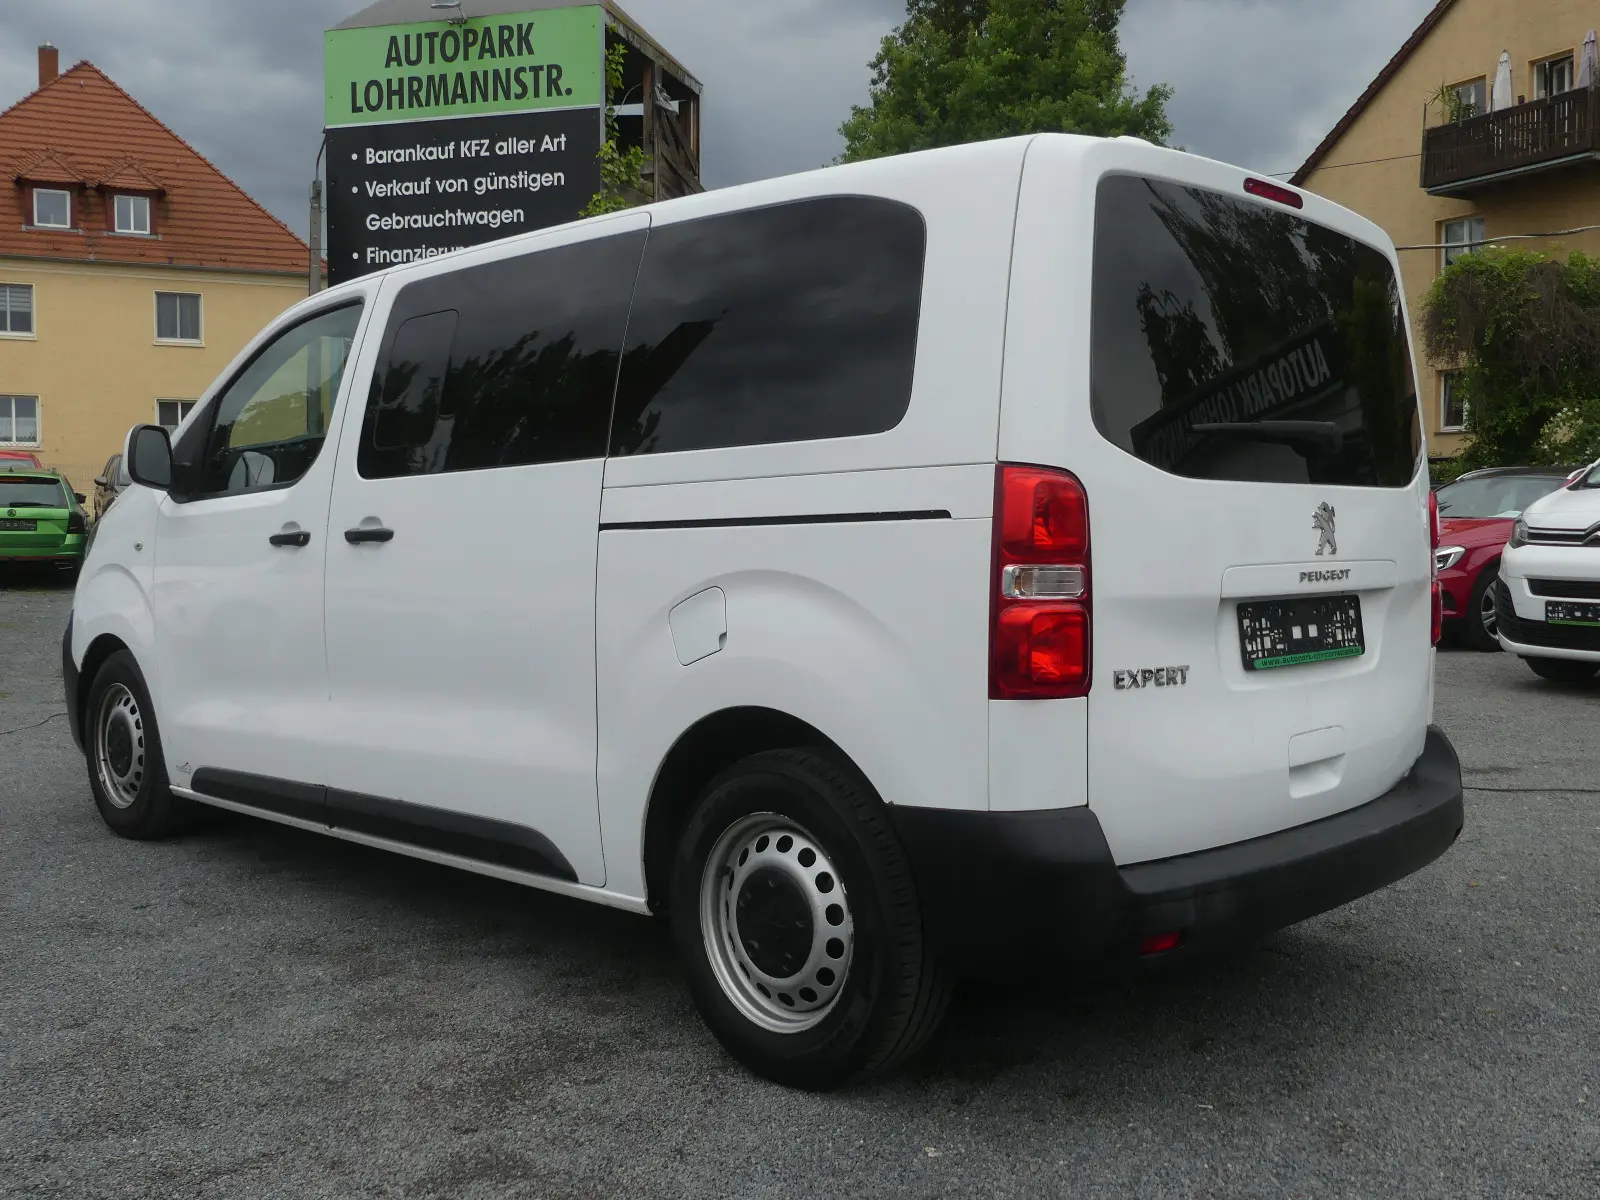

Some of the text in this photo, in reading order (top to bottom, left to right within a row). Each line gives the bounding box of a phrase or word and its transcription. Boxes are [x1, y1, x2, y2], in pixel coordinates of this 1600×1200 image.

[384, 22, 535, 68] AUTOPARK
[351, 63, 573, 114] LOHRMANNSTR.
[365, 133, 567, 165] Barankauf KFZ aller Art
[365, 171, 565, 198] Verkauf von günstigen
[365, 207, 525, 231] Gebrauchtwagen
[366, 244, 467, 264] Finanzier
[1299, 568, 1351, 584] PEUGEOT
[1113, 665, 1190, 690] EXPERT
